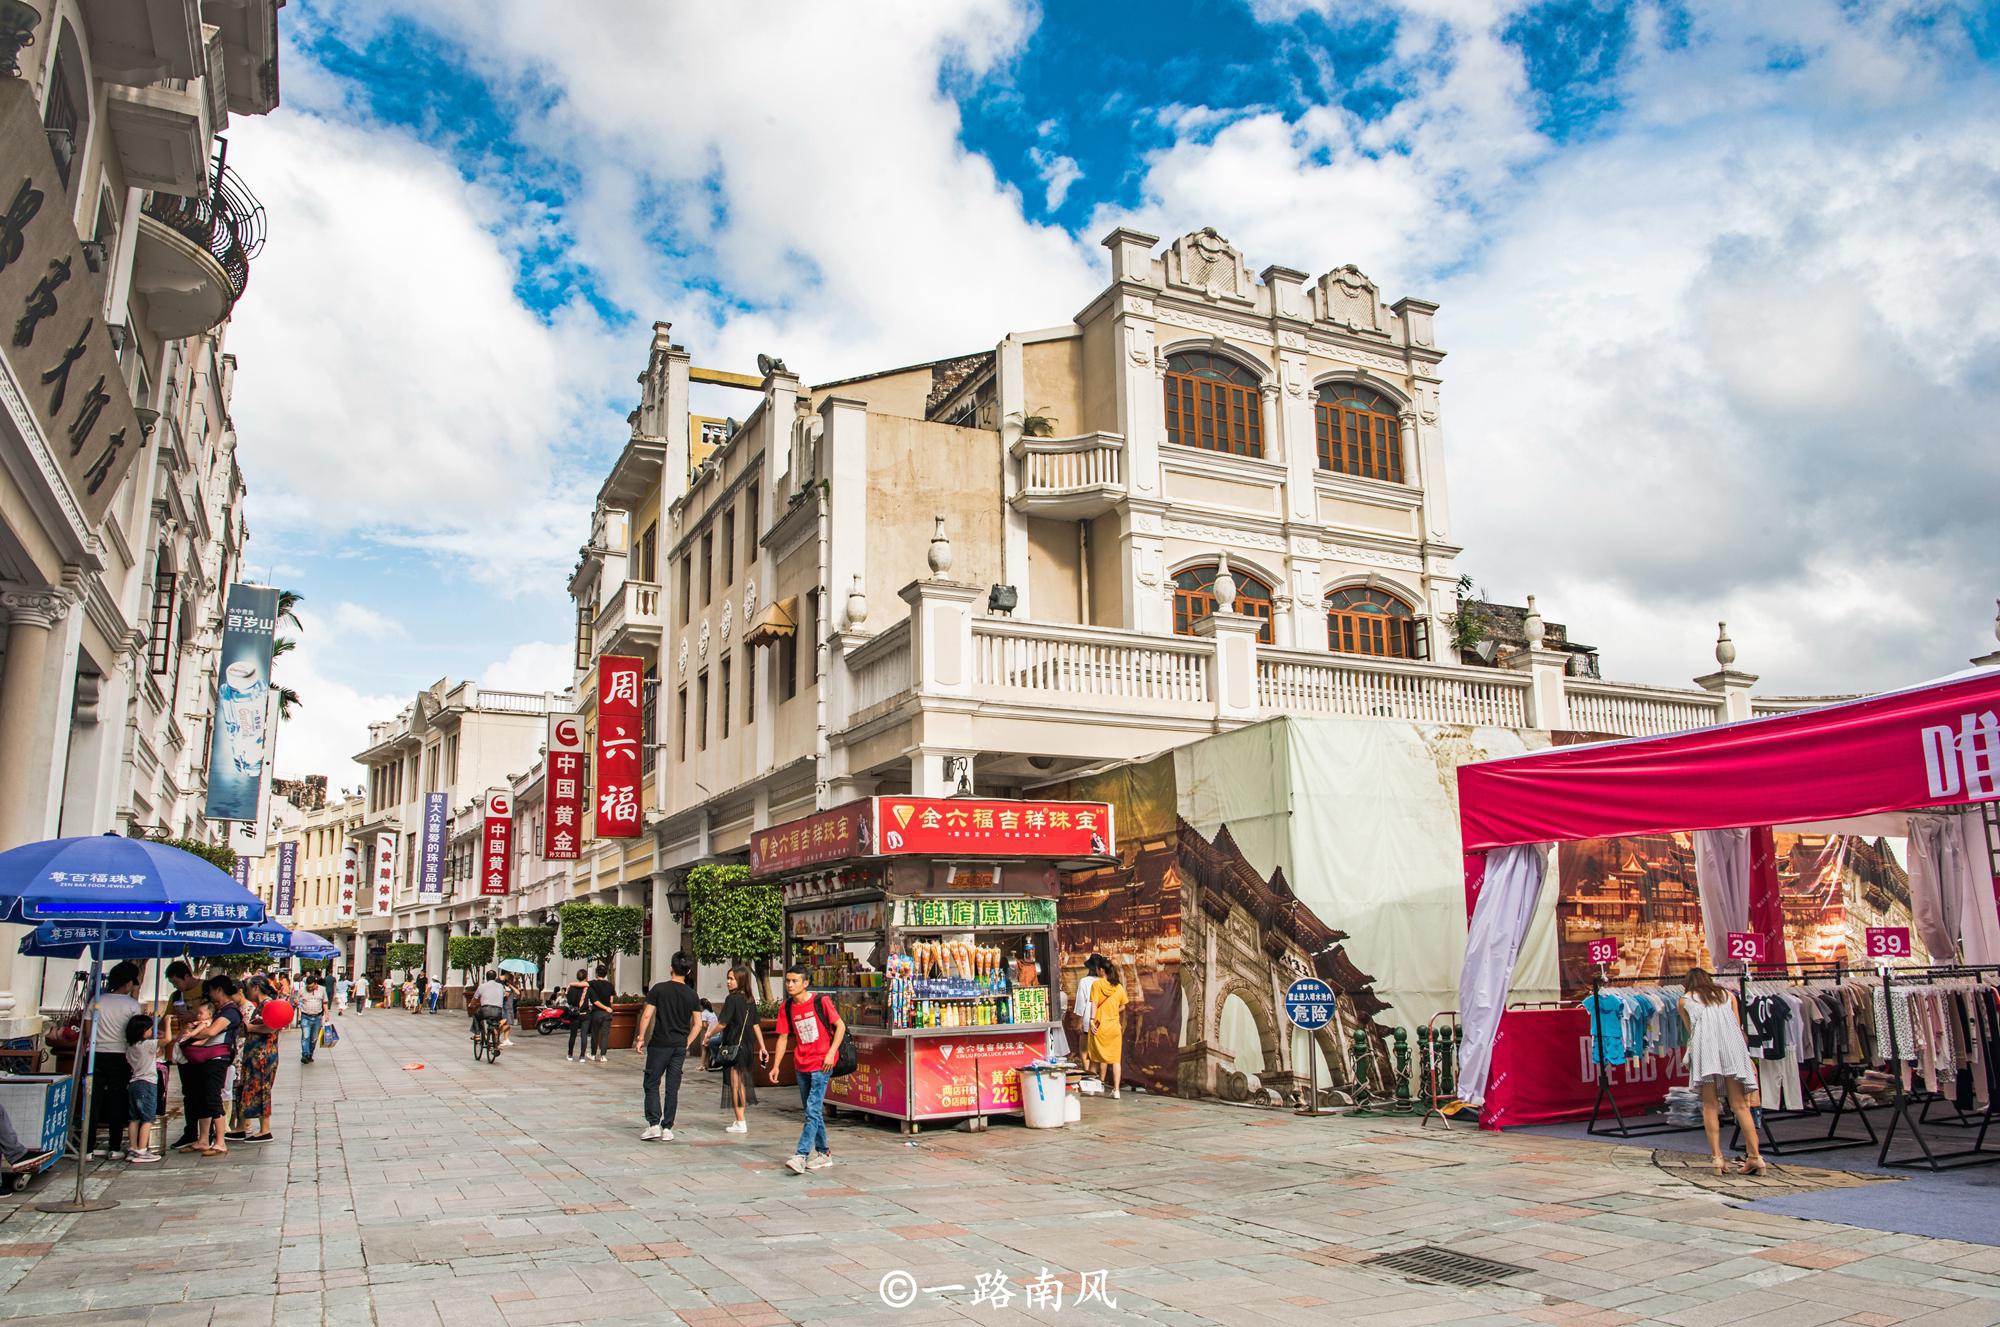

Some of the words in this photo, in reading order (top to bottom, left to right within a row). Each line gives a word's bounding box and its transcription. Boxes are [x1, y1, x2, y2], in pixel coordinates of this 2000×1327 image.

[228, 614, 273, 630] 百岁山
[600, 670, 638, 823] 周六福
[553, 754, 576, 851] 中国黄金
[918, 806, 1099, 831] 金六福吉祥珠宝
[425, 794, 442, 893] 做大众喜爱的珠宝品牌
[769, 816, 849, 858] 金六福吉祥珠宝
[488, 823, 506, 888] 中国黄金
[280, 842, 294, 915] 做大众喜爱的珠宝品牌
[342, 858, 355, 915] 安踏体育
[378, 851, 392, 912] 安踏体育
[923, 902, 1029, 923] 鲜榨蔗汁
[50, 928, 109, 940] 尊百福珠
[1592, 944, 1611, 960] 39
[1732, 939, 1757, 957] 29
[1873, 935, 1902, 953] 39
[1018, 989, 1045, 1003] 鲜榨
[1018, 1006, 1045, 1020] 蔗汁
[1293, 1005, 1328, 1022] 危险
[992, 1067, 1024, 1085] 黄金
[992, 1087, 1019, 1104] 225
